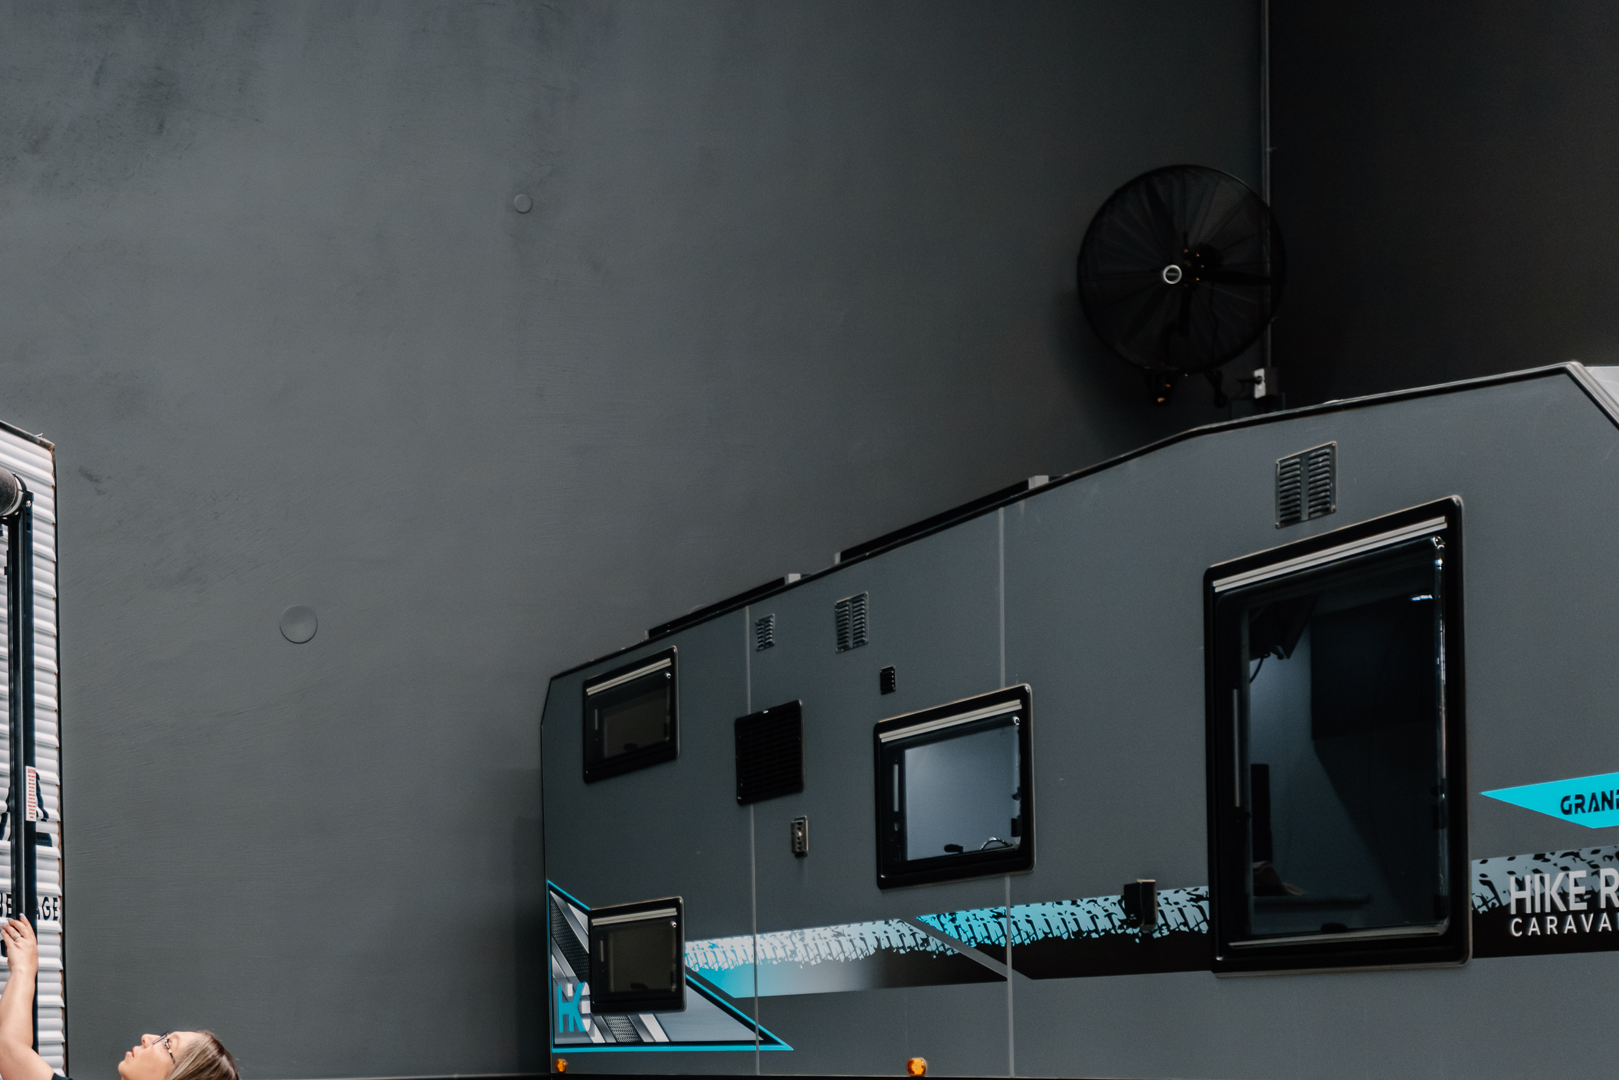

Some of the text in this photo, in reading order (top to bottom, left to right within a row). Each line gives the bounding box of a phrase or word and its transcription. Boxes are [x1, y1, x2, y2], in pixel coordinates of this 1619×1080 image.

[1510, 870, 1588, 915] HIKE
[36, 896, 58, 921] GE
[1510, 912, 1619, 937] CARAVA
